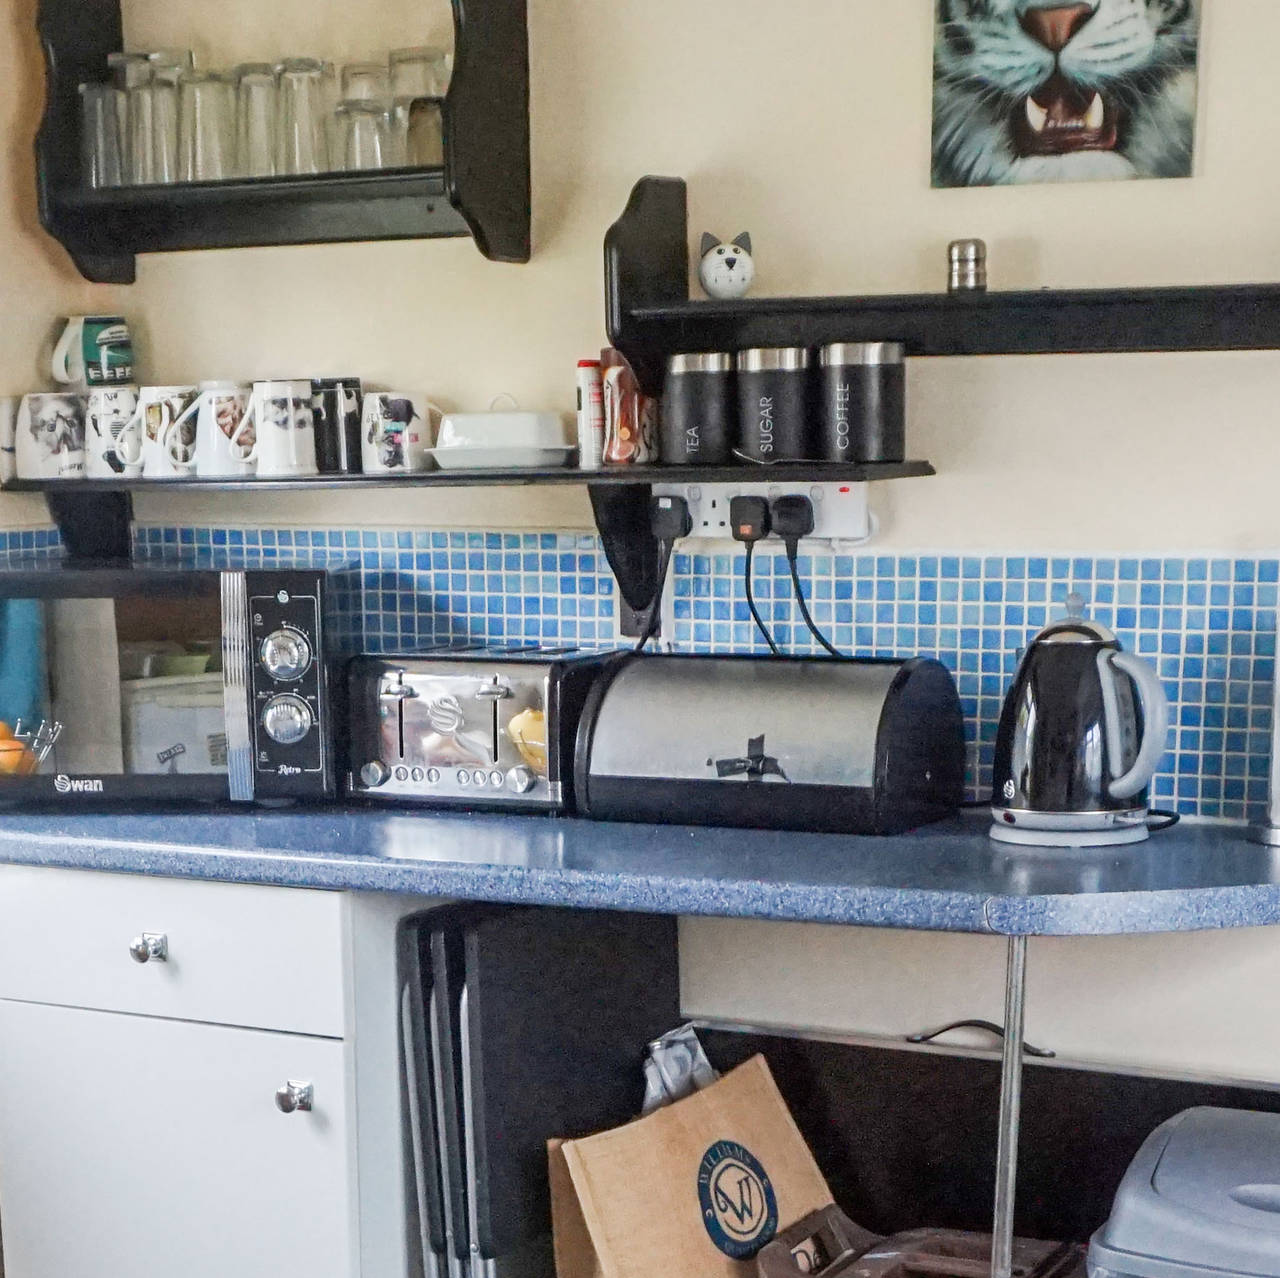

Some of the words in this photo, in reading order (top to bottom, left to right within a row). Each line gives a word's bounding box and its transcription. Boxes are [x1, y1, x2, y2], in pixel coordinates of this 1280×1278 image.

[759, 396, 774, 453] SUGAR
[836, 383, 850, 450] COFFEE
[686, 425, 700, 453] TEA
[54, 774, 104, 792] Swan
